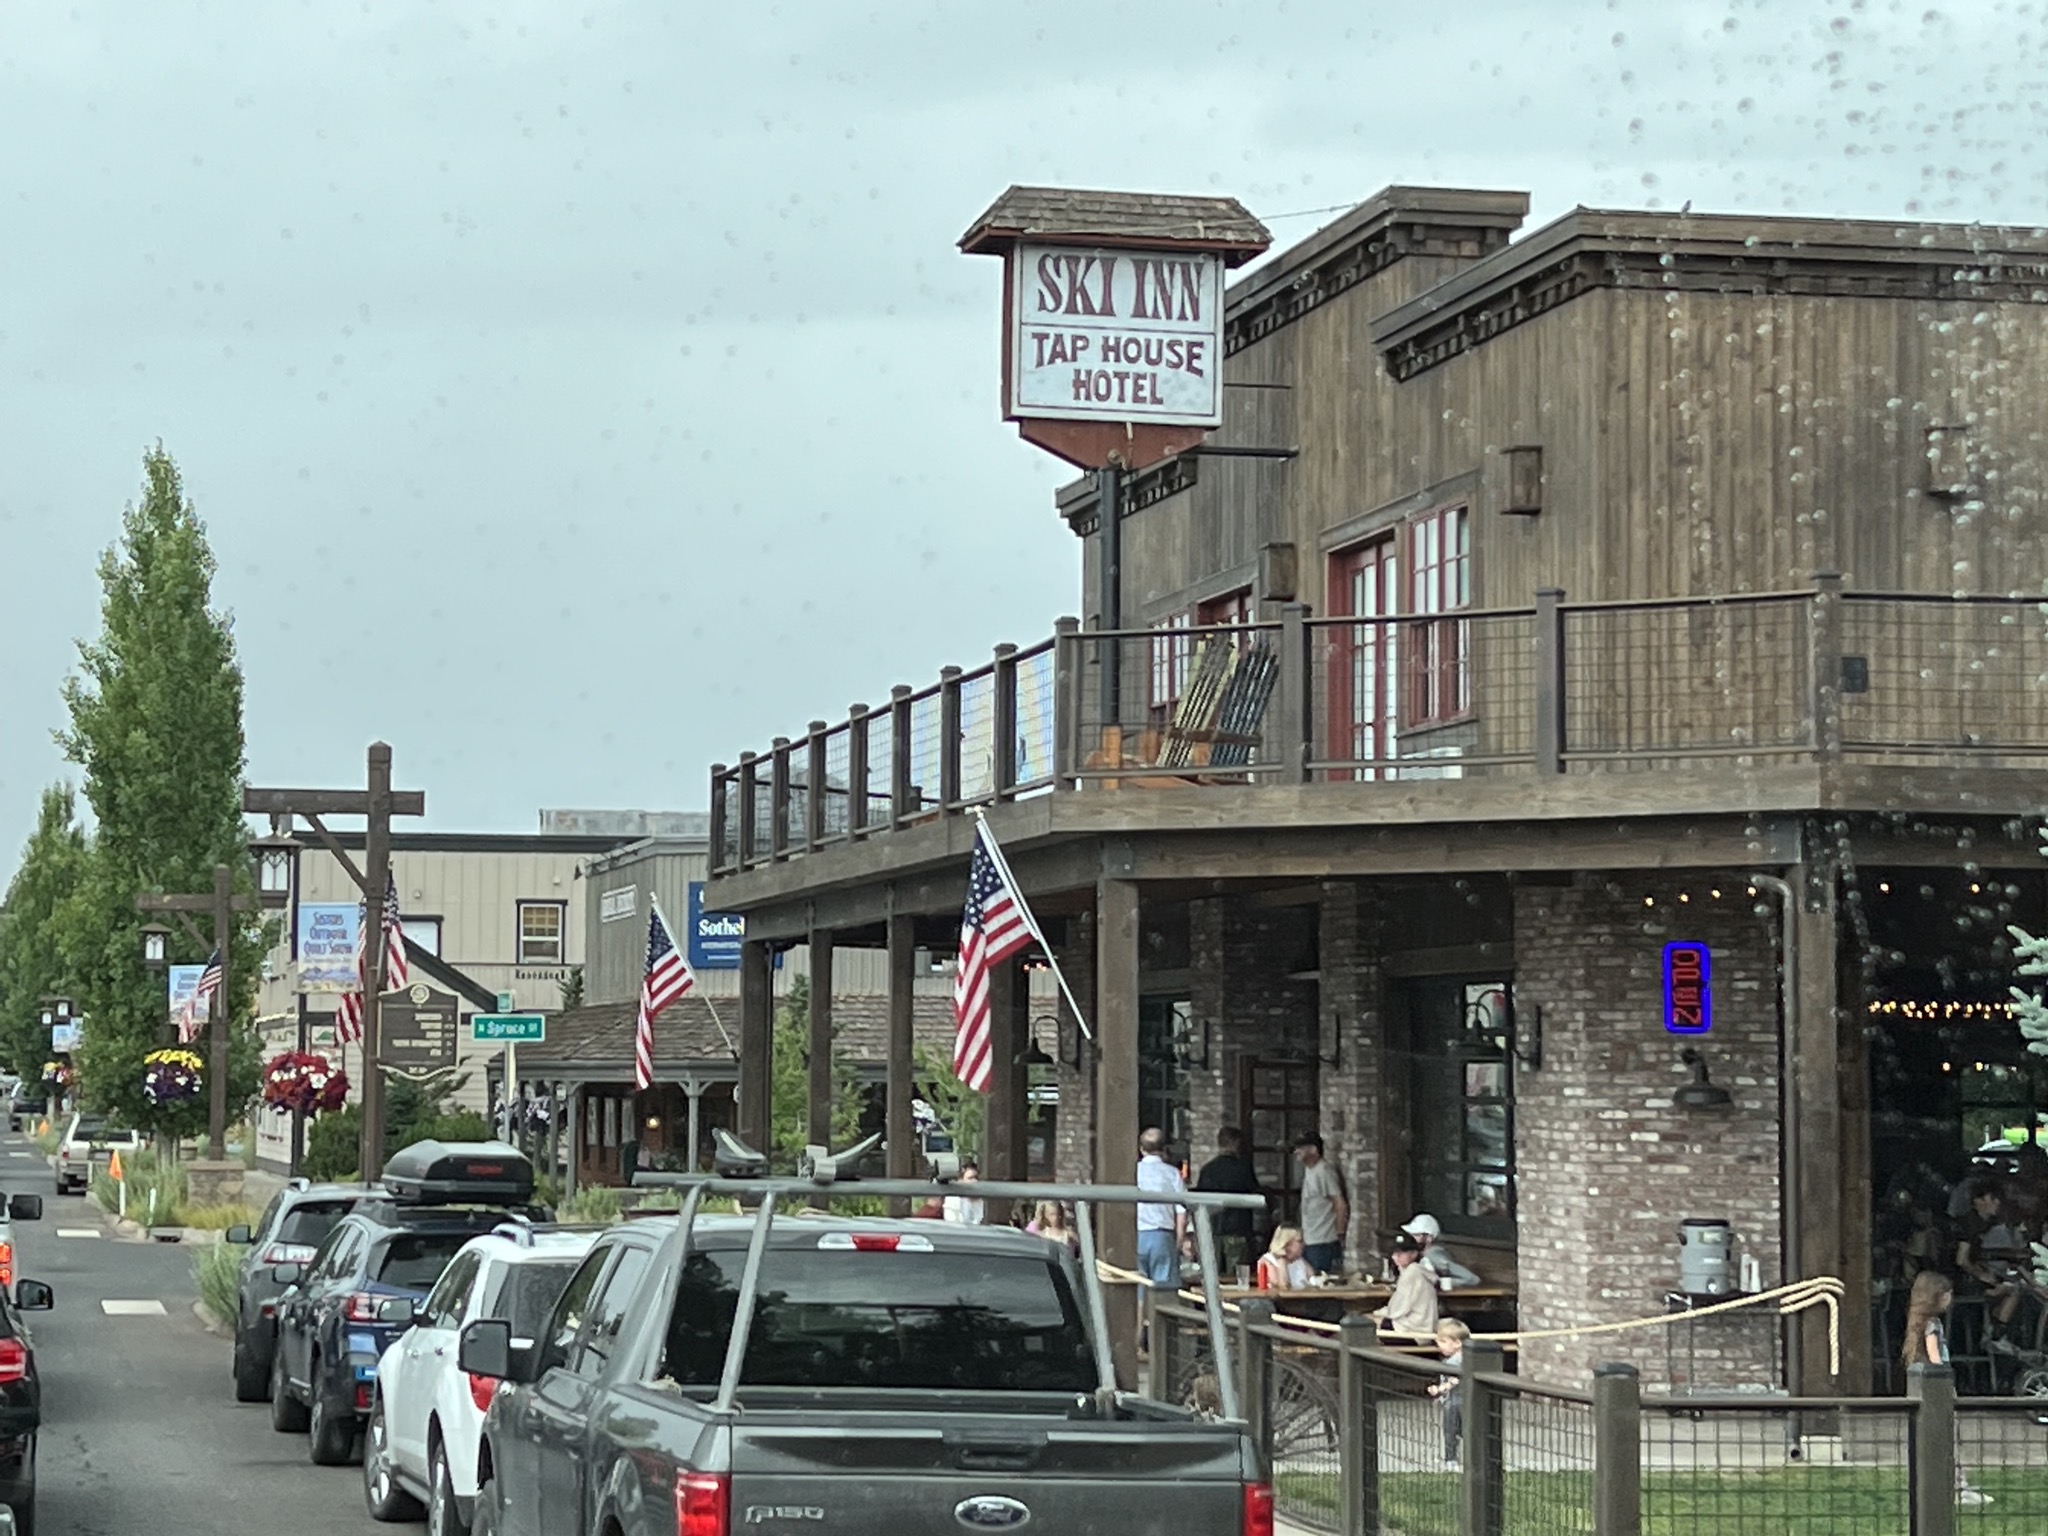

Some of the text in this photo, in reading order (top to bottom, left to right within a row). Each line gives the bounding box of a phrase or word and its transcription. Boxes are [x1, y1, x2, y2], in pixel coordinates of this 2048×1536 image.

[1037, 253, 1204, 322] SKI INN
[1031, 332, 1205, 379] TAP HOUSE
[1072, 368, 1164, 406] HOTEL
[1672, 949, 1702, 1025] OPEN
[486, 1020, 526, 1036] Spruce
